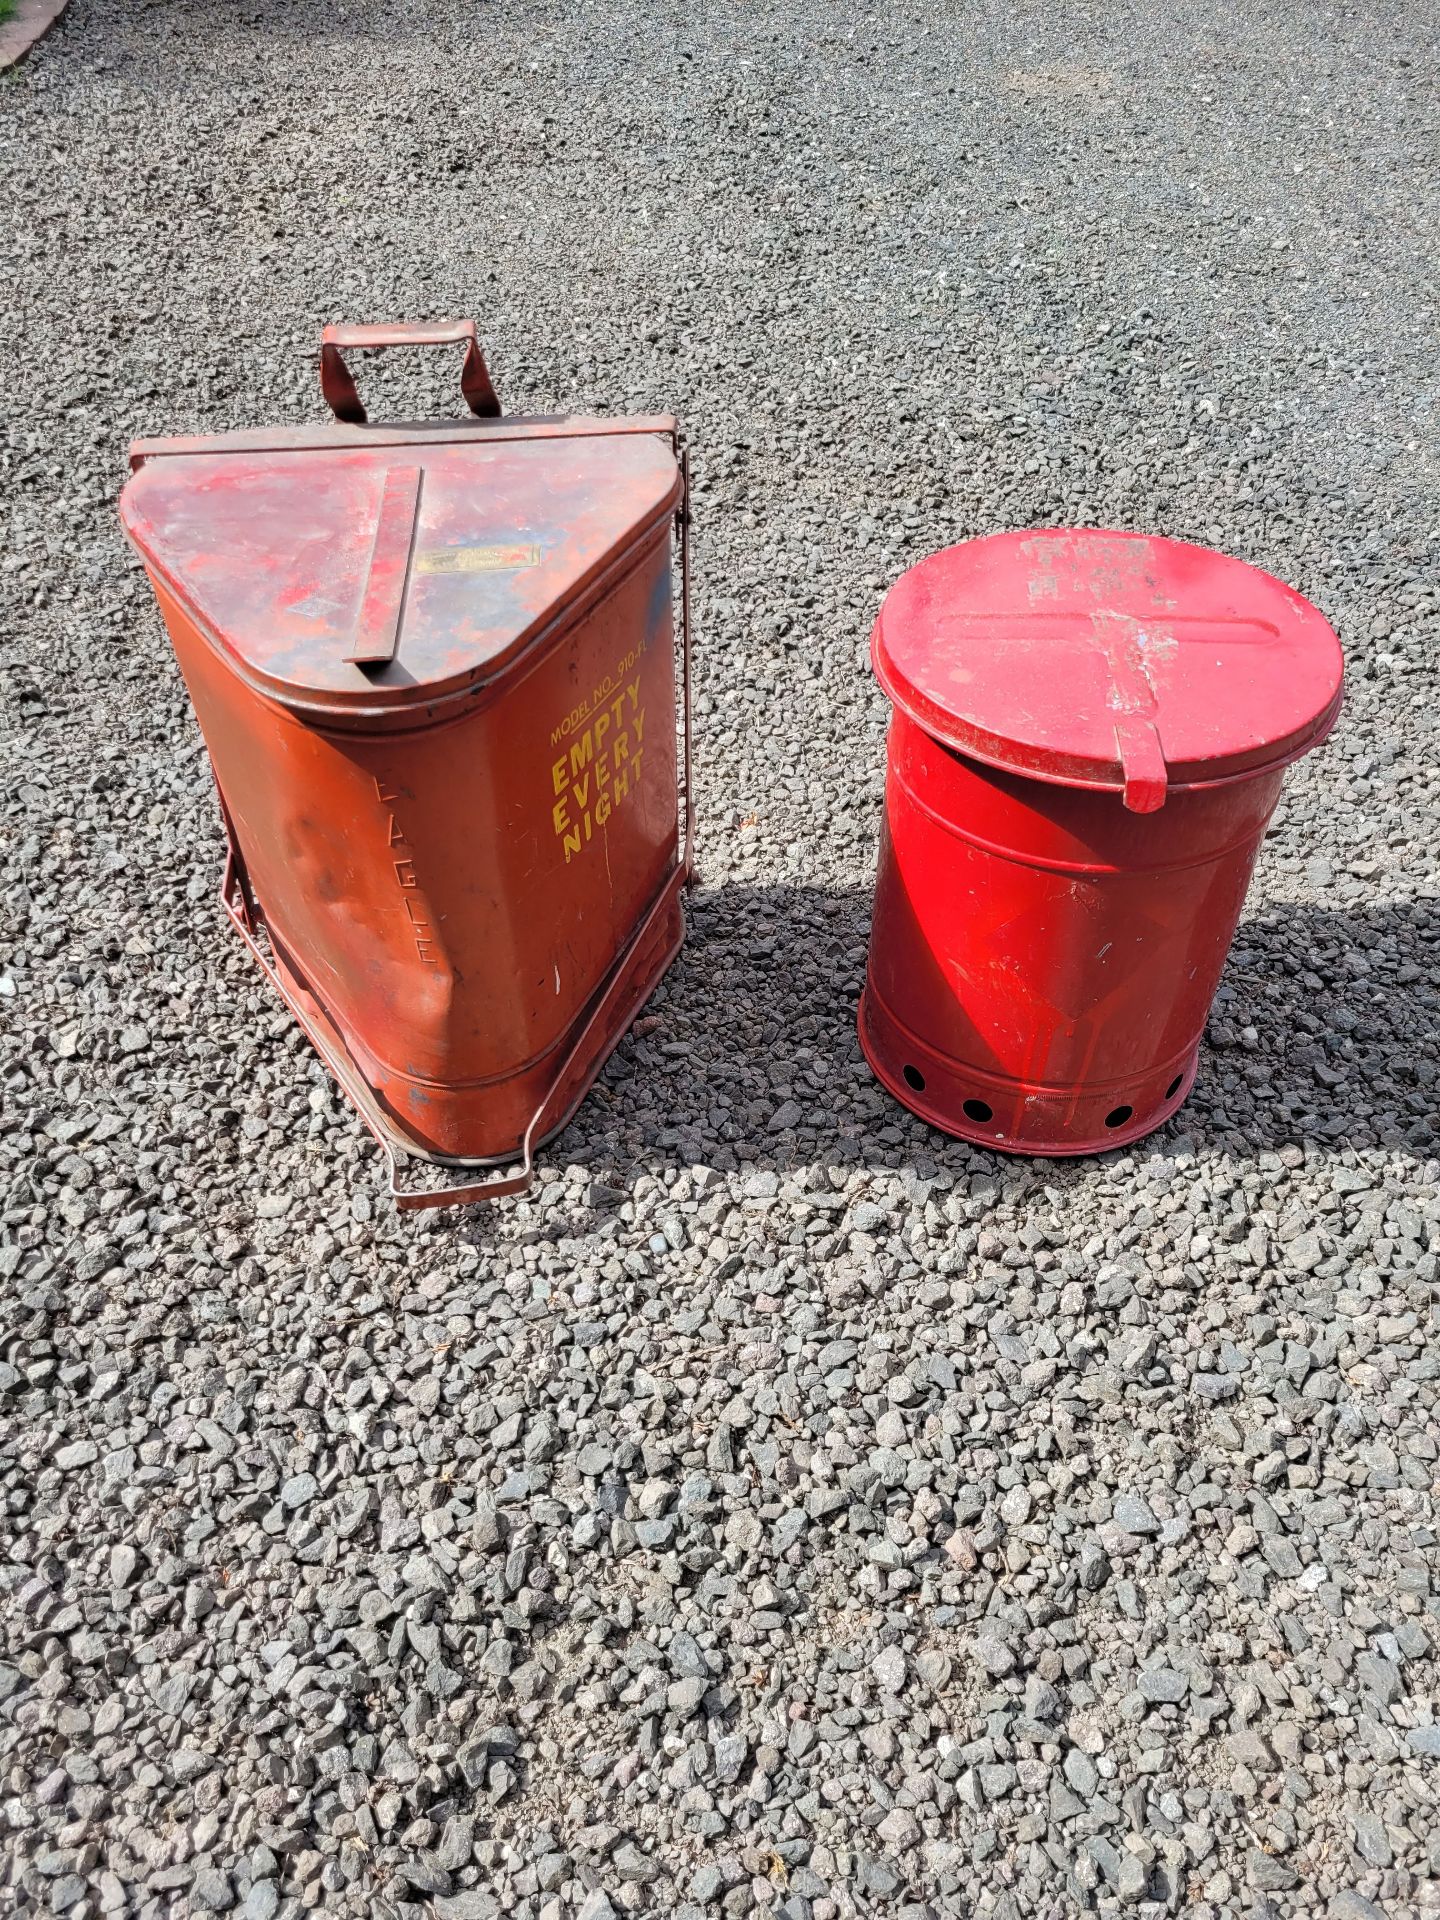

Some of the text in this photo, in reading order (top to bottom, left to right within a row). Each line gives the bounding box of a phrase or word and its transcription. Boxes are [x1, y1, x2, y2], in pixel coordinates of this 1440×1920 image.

[550, 699, 590, 747] MODEL
[593, 675, 614, 704] NO.
[552, 675, 641, 796] EMPTY
[552, 708, 645, 835] EVERY
[563, 747, 644, 864] NIGHT
[373, 775, 438, 963] EAGLE
